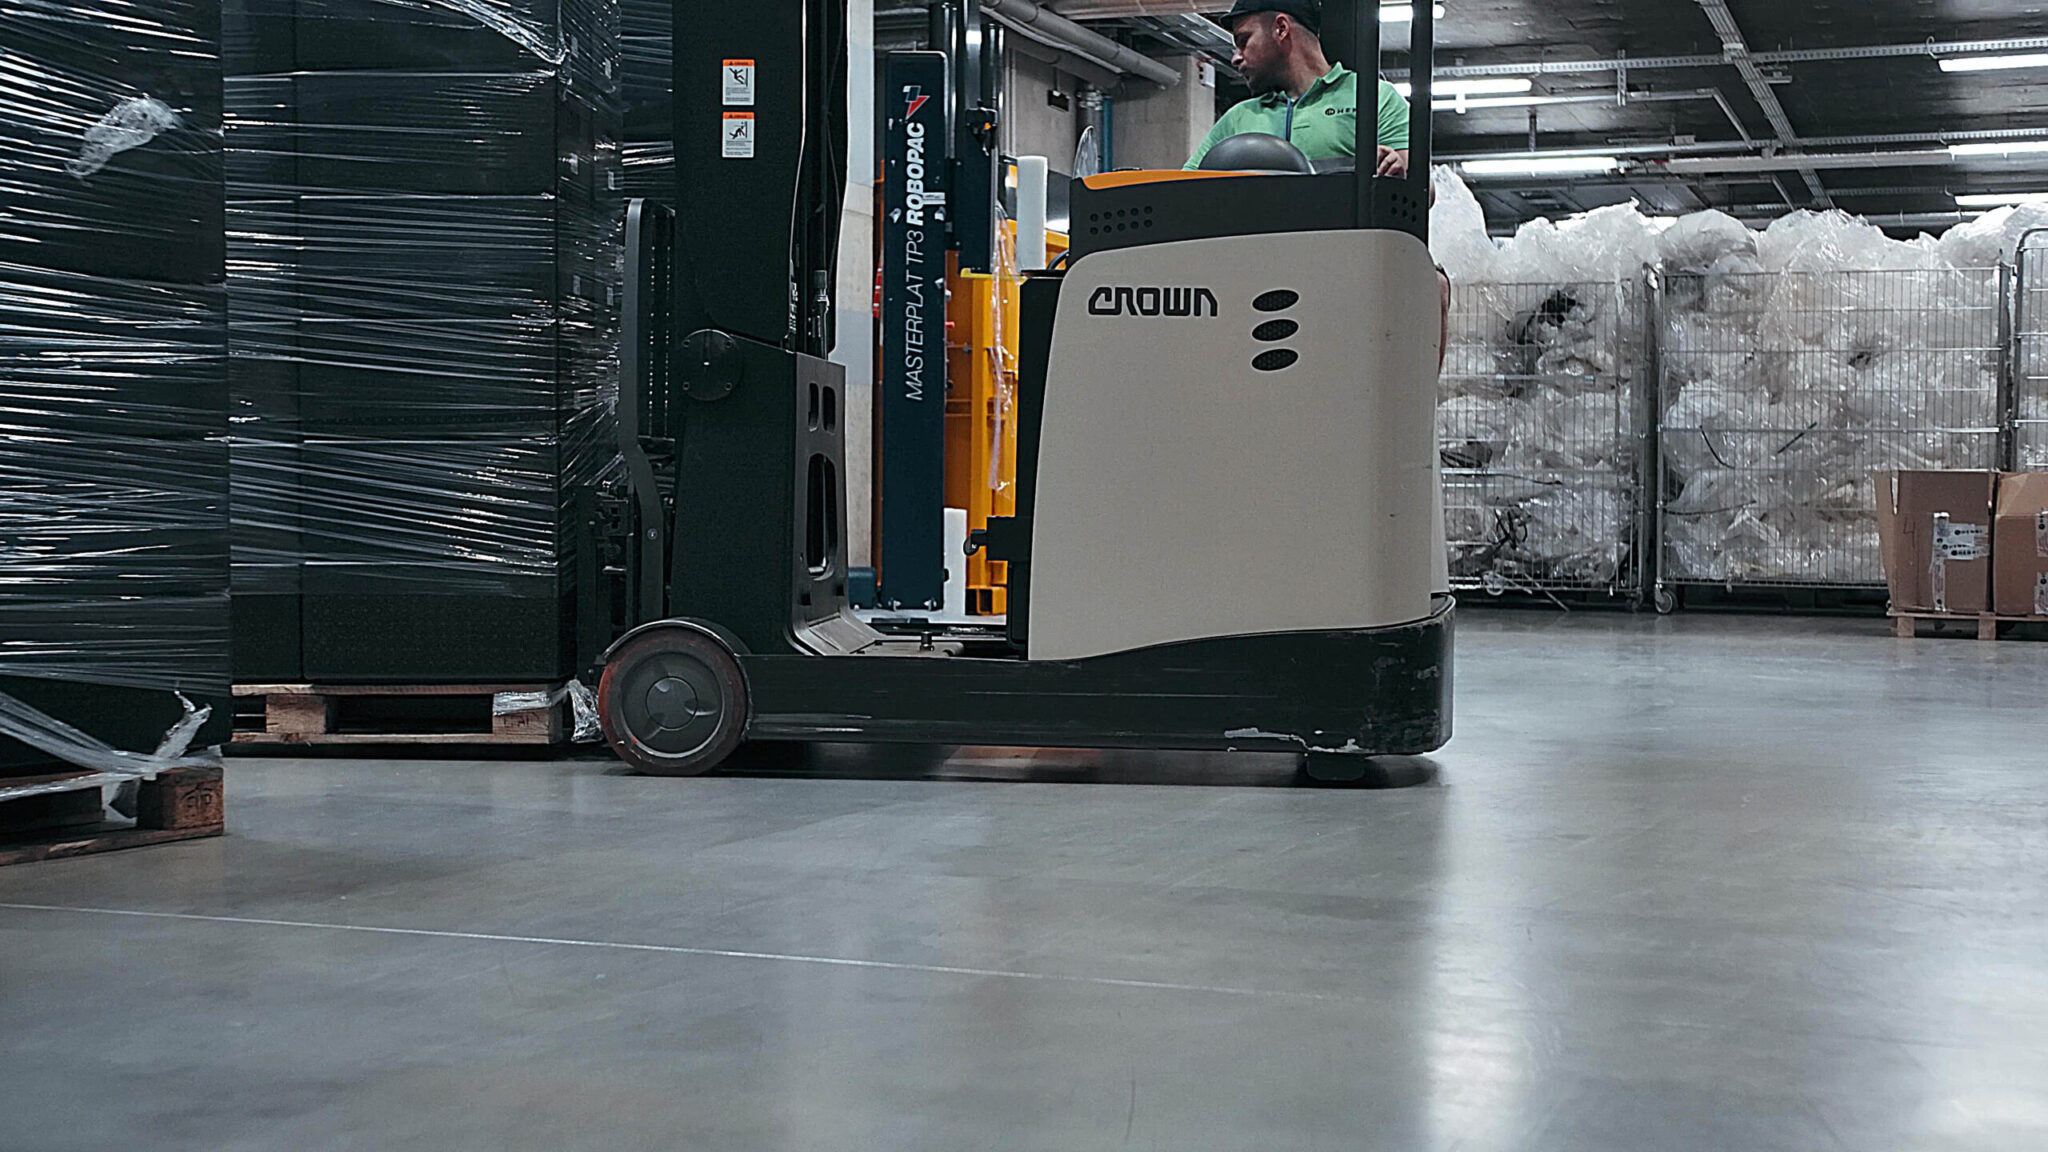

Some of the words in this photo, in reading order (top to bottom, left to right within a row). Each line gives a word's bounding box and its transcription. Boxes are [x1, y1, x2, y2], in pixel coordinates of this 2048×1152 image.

[906, 122, 925, 226] ROBOPAC
[905, 229, 925, 266] TP3
[905, 269, 924, 401] MASTERPLAT
[1088, 286, 1218, 317] CROWN
